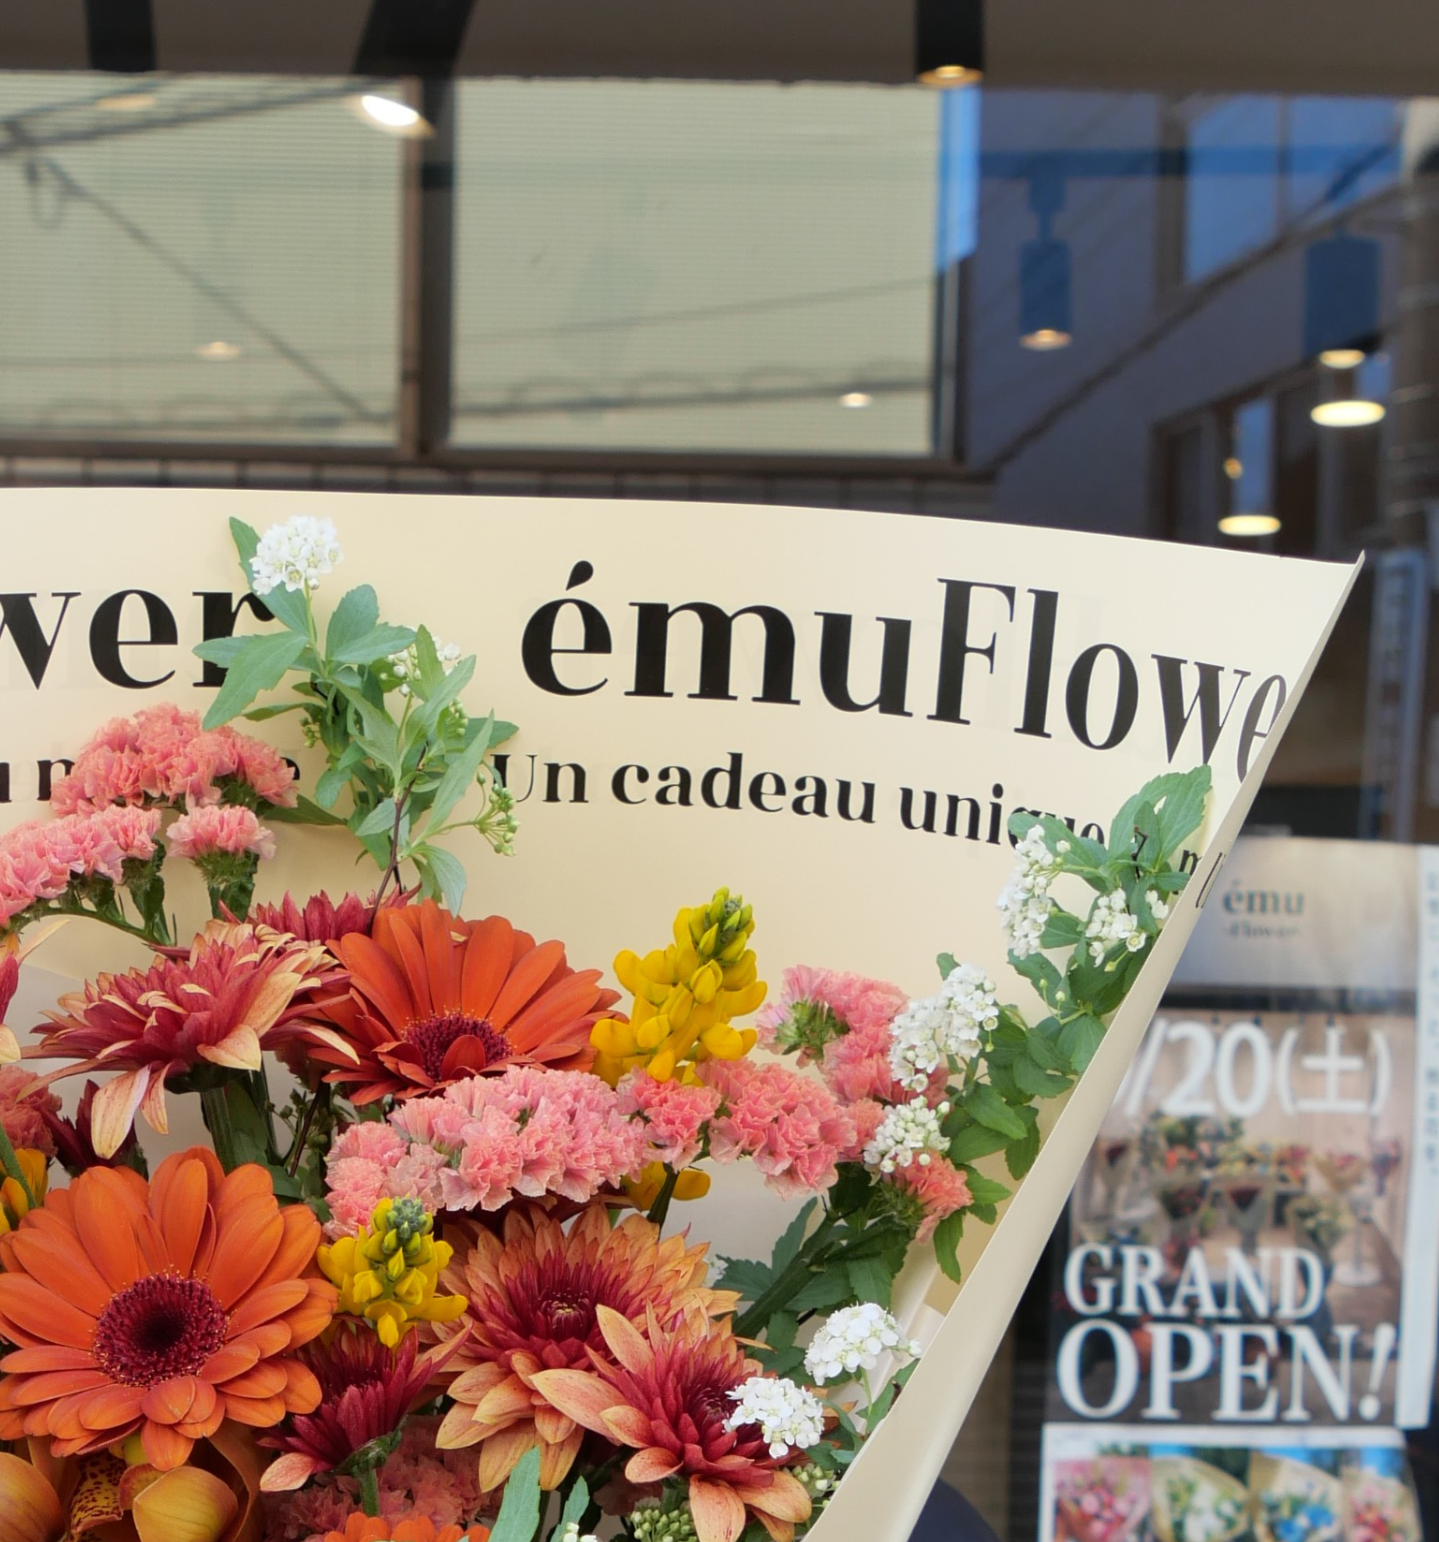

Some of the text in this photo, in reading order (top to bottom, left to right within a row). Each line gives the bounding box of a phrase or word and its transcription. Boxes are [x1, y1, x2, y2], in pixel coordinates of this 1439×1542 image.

[491, 753, 590, 804] Un
[611, 752, 877, 825] cadeau
[1064, 1242, 1325, 1320] GRAND
[1057, 1317, 1397, 1423] OPEN!
